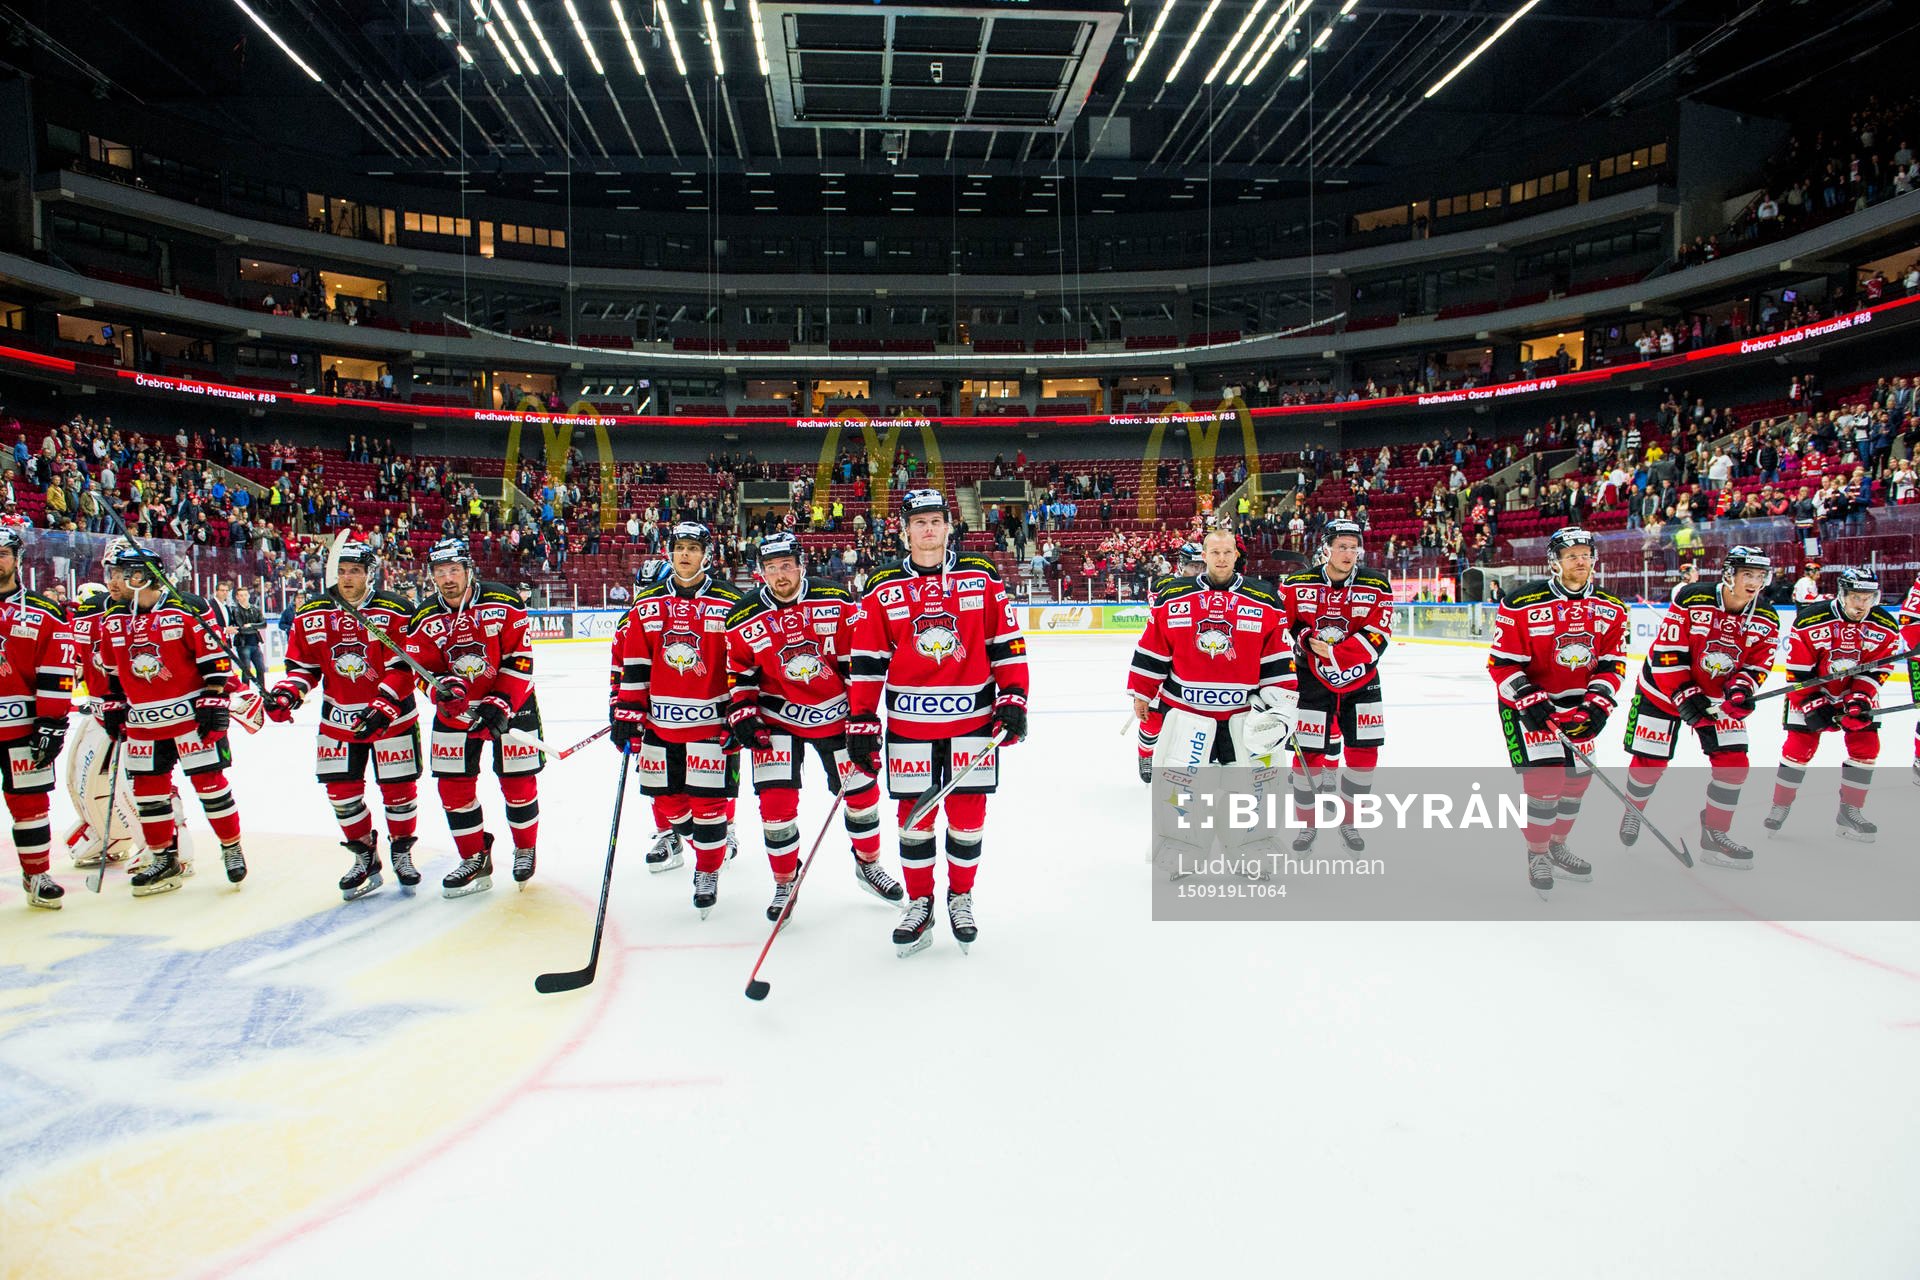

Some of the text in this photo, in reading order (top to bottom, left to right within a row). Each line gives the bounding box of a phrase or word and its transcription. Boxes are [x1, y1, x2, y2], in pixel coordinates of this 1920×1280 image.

[1740, 312, 1872, 354] Örebro: Jacub Petruzalek #88
[135, 374, 276, 402] Örebro: Jacub Petruzalek #88
[1418, 394, 1466, 406] Redhawks:
[1468, 390, 1493, 400] Oscar
[1540, 380, 1557, 390] #69
[474, 412, 522, 422] Redhawks:
[526, 414, 550, 424] Oscar
[600, 418, 616, 426] #69
[796, 420, 842, 428] Redhawks:
[844, 420, 867, 428] Oscar
[914, 420, 930, 428] #69
[1110, 412, 1236, 424] Örebro: Jacub Petruzalek #88
[1904, 596, 1920, 610] 12
[542, 616, 564, 630] TAK
[1660, 624, 1680, 642] 20
[824, 636, 836, 655] A
[61, 644, 75, 664] 72
[898, 694, 972, 712] areco
[1184, 688, 1244, 704] areco
[130, 704, 188, 722] areco
[332, 710, 362, 724] are
[653, 704, 714, 720] areco
[785, 701, 848, 724] areco
[1502, 708, 1522, 764] akea
[1636, 725, 1671, 742] MAXI
[318, 746, 347, 758] MAXI
[377, 749, 414, 763] MAXI
[432, 744, 463, 757] MAXI
[754, 751, 790, 764] MAXI
[688, 756, 724, 771] MAXI
[890, 758, 930, 774] MAXI
